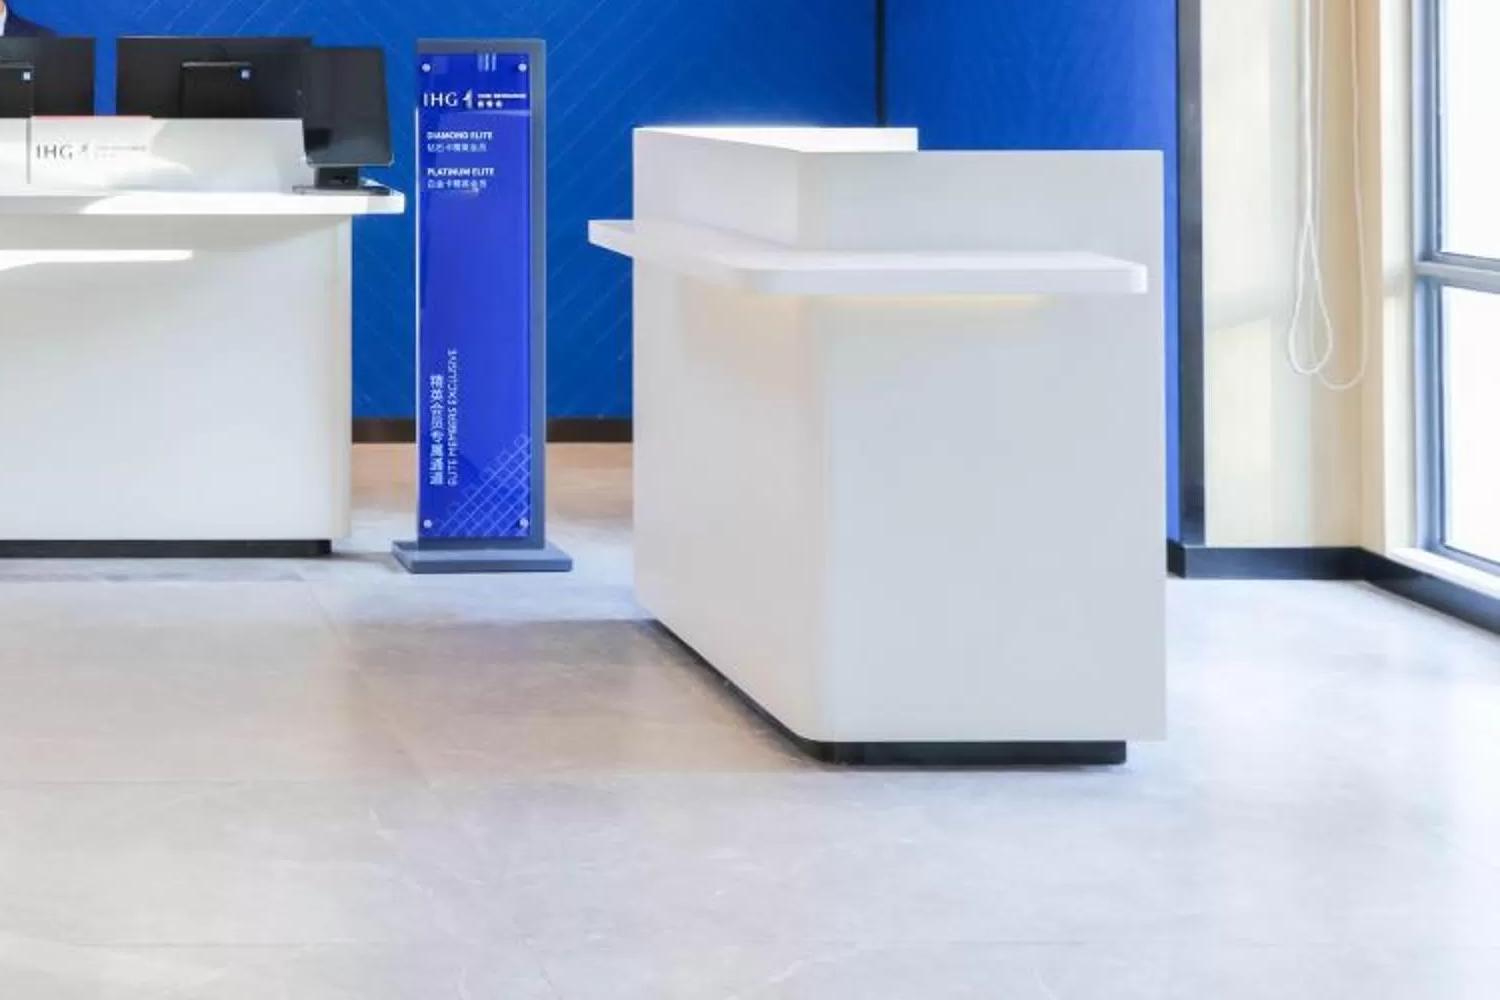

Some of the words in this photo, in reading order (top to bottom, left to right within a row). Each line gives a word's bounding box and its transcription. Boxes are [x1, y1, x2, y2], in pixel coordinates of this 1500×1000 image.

[423, 91, 459, 107] IHG
[426, 131, 469, 140] DIAMOND
[470, 131, 493, 140] ELITE
[35, 143, 74, 160] IHG
[427, 167, 471, 177] PLATINUM
[471, 167, 495, 177] ELITE
[447, 348, 458, 405] EXCLUSIVE
[447, 408, 458, 457] MEMBERS
[447, 459, 458, 487] ELITE
